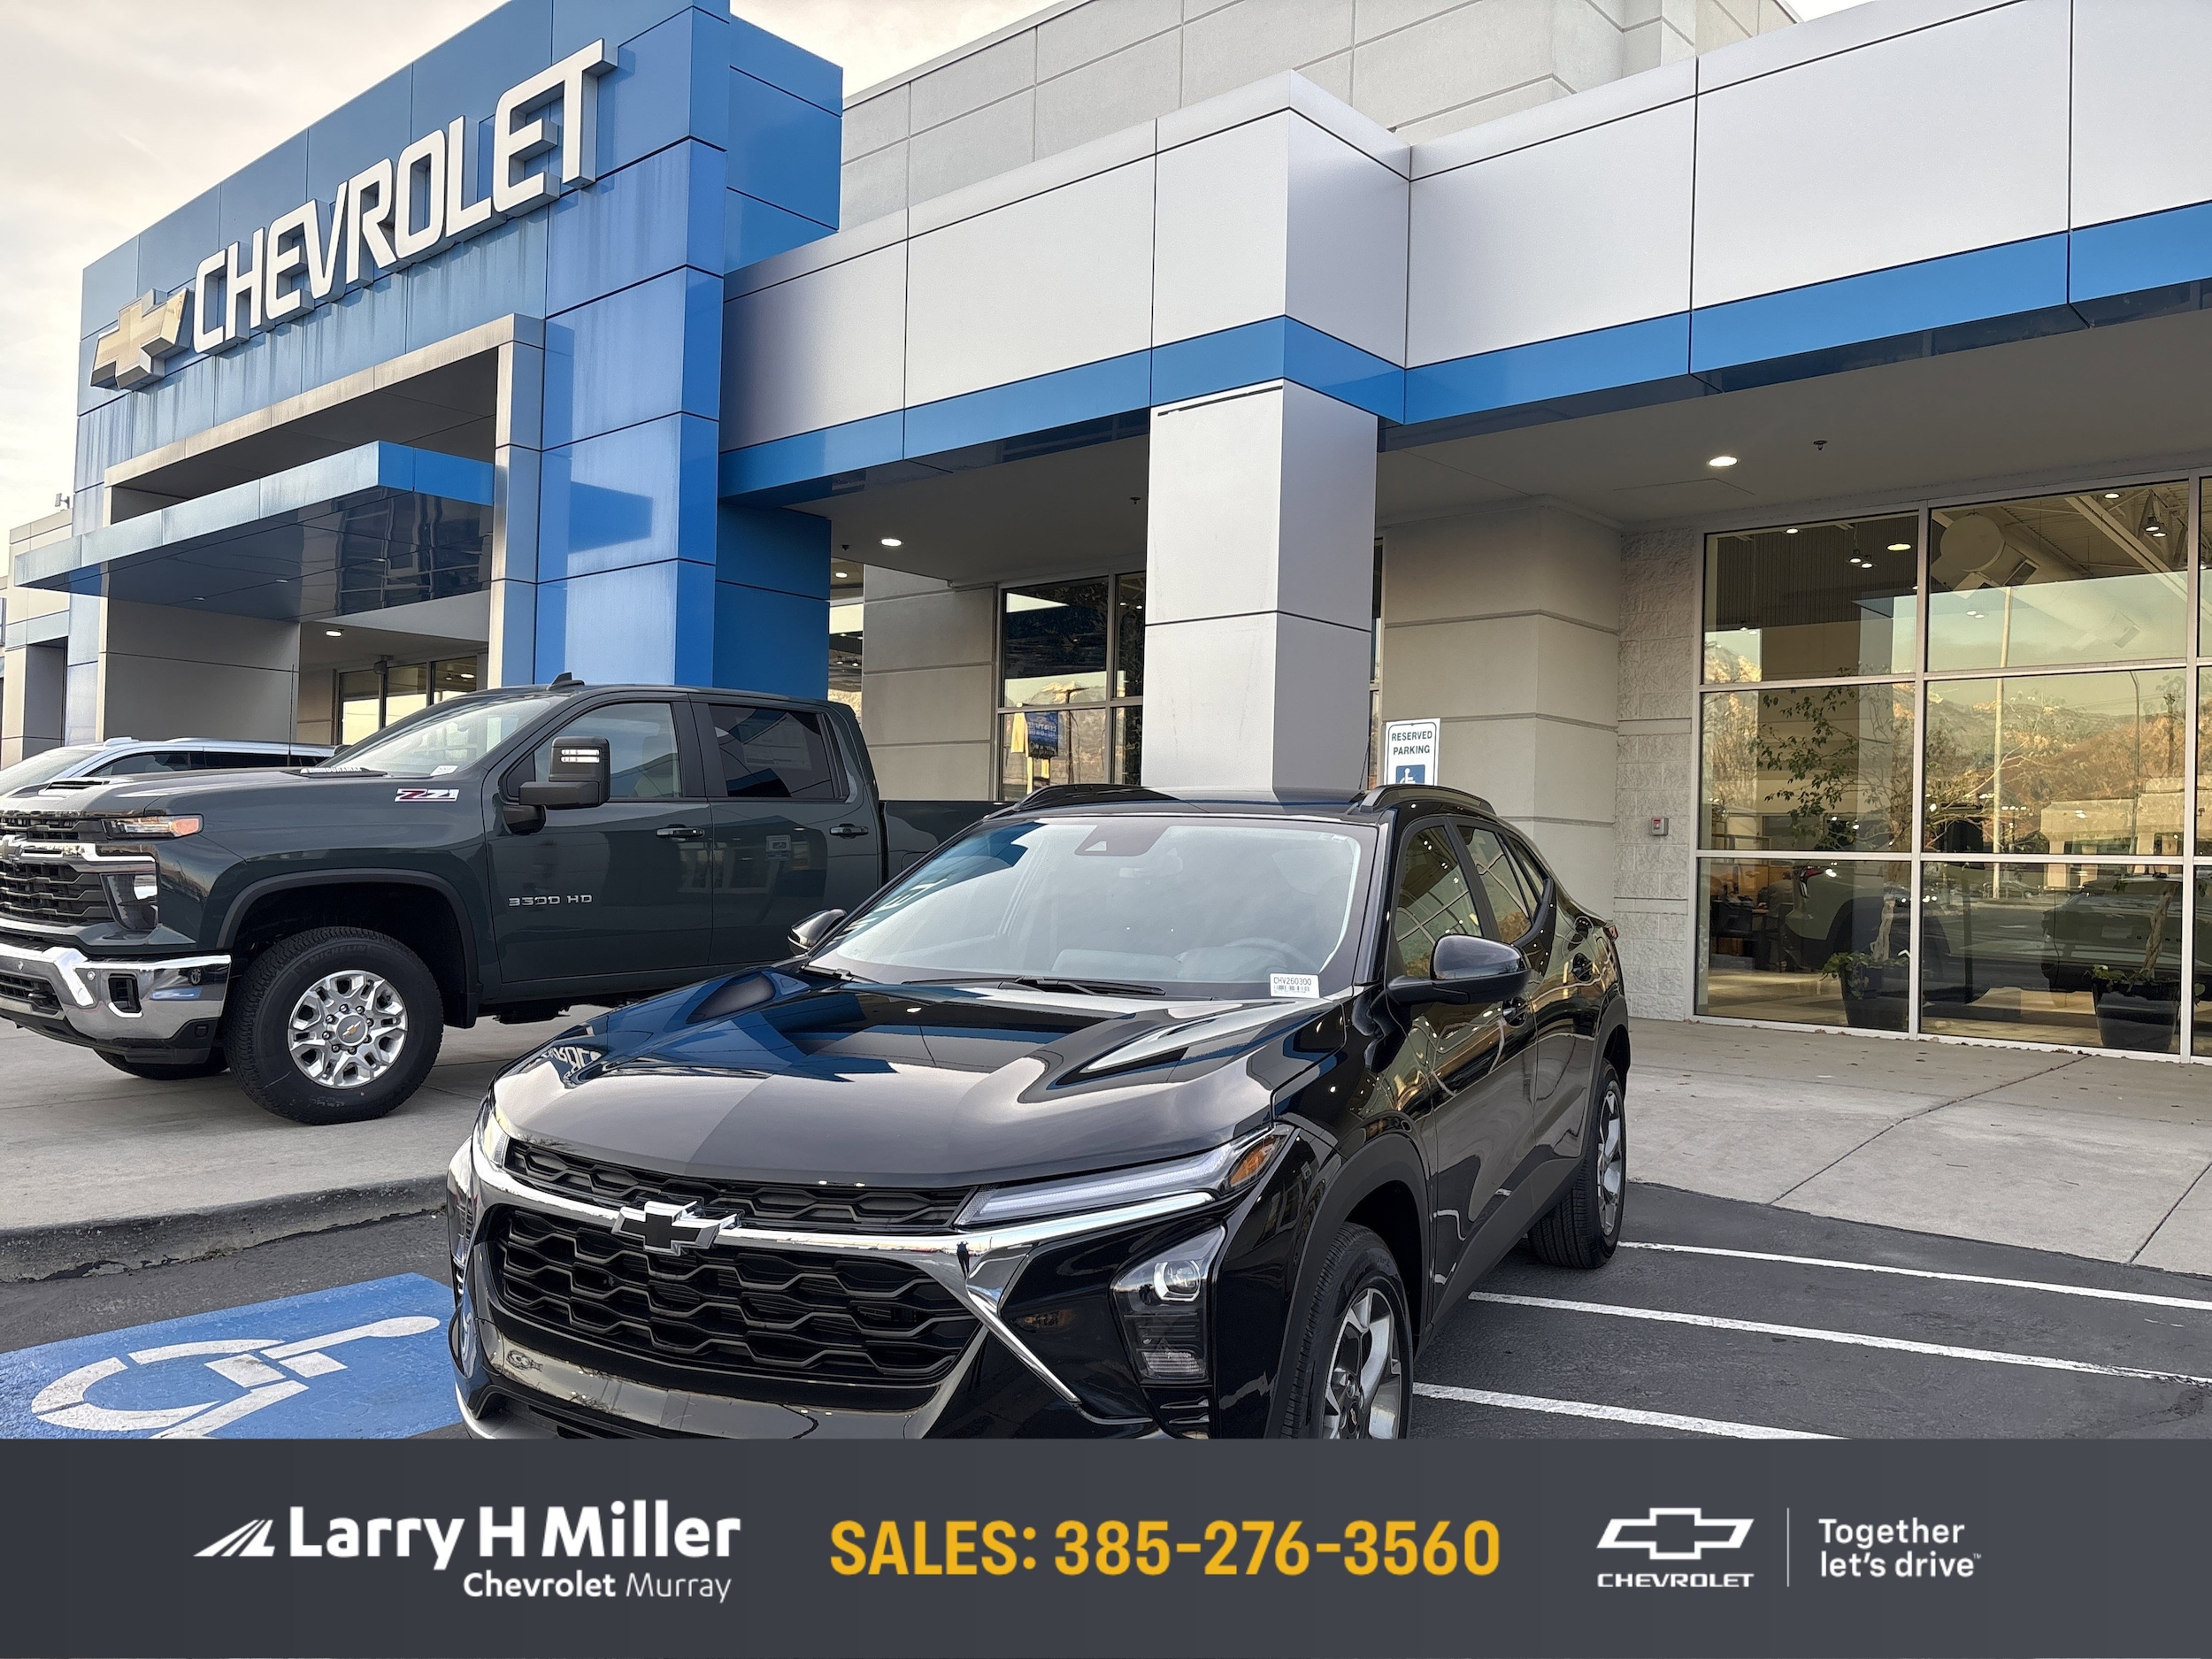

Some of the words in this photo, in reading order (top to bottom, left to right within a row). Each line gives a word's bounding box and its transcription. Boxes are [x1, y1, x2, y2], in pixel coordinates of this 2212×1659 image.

[193, 38, 611, 354] CHEVROLET
[1392, 731, 1432, 741] RESERVED
[1394, 745, 1430, 756] PARKING
[395, 788, 460, 802] Z71
[566, 895, 593, 904] HD
